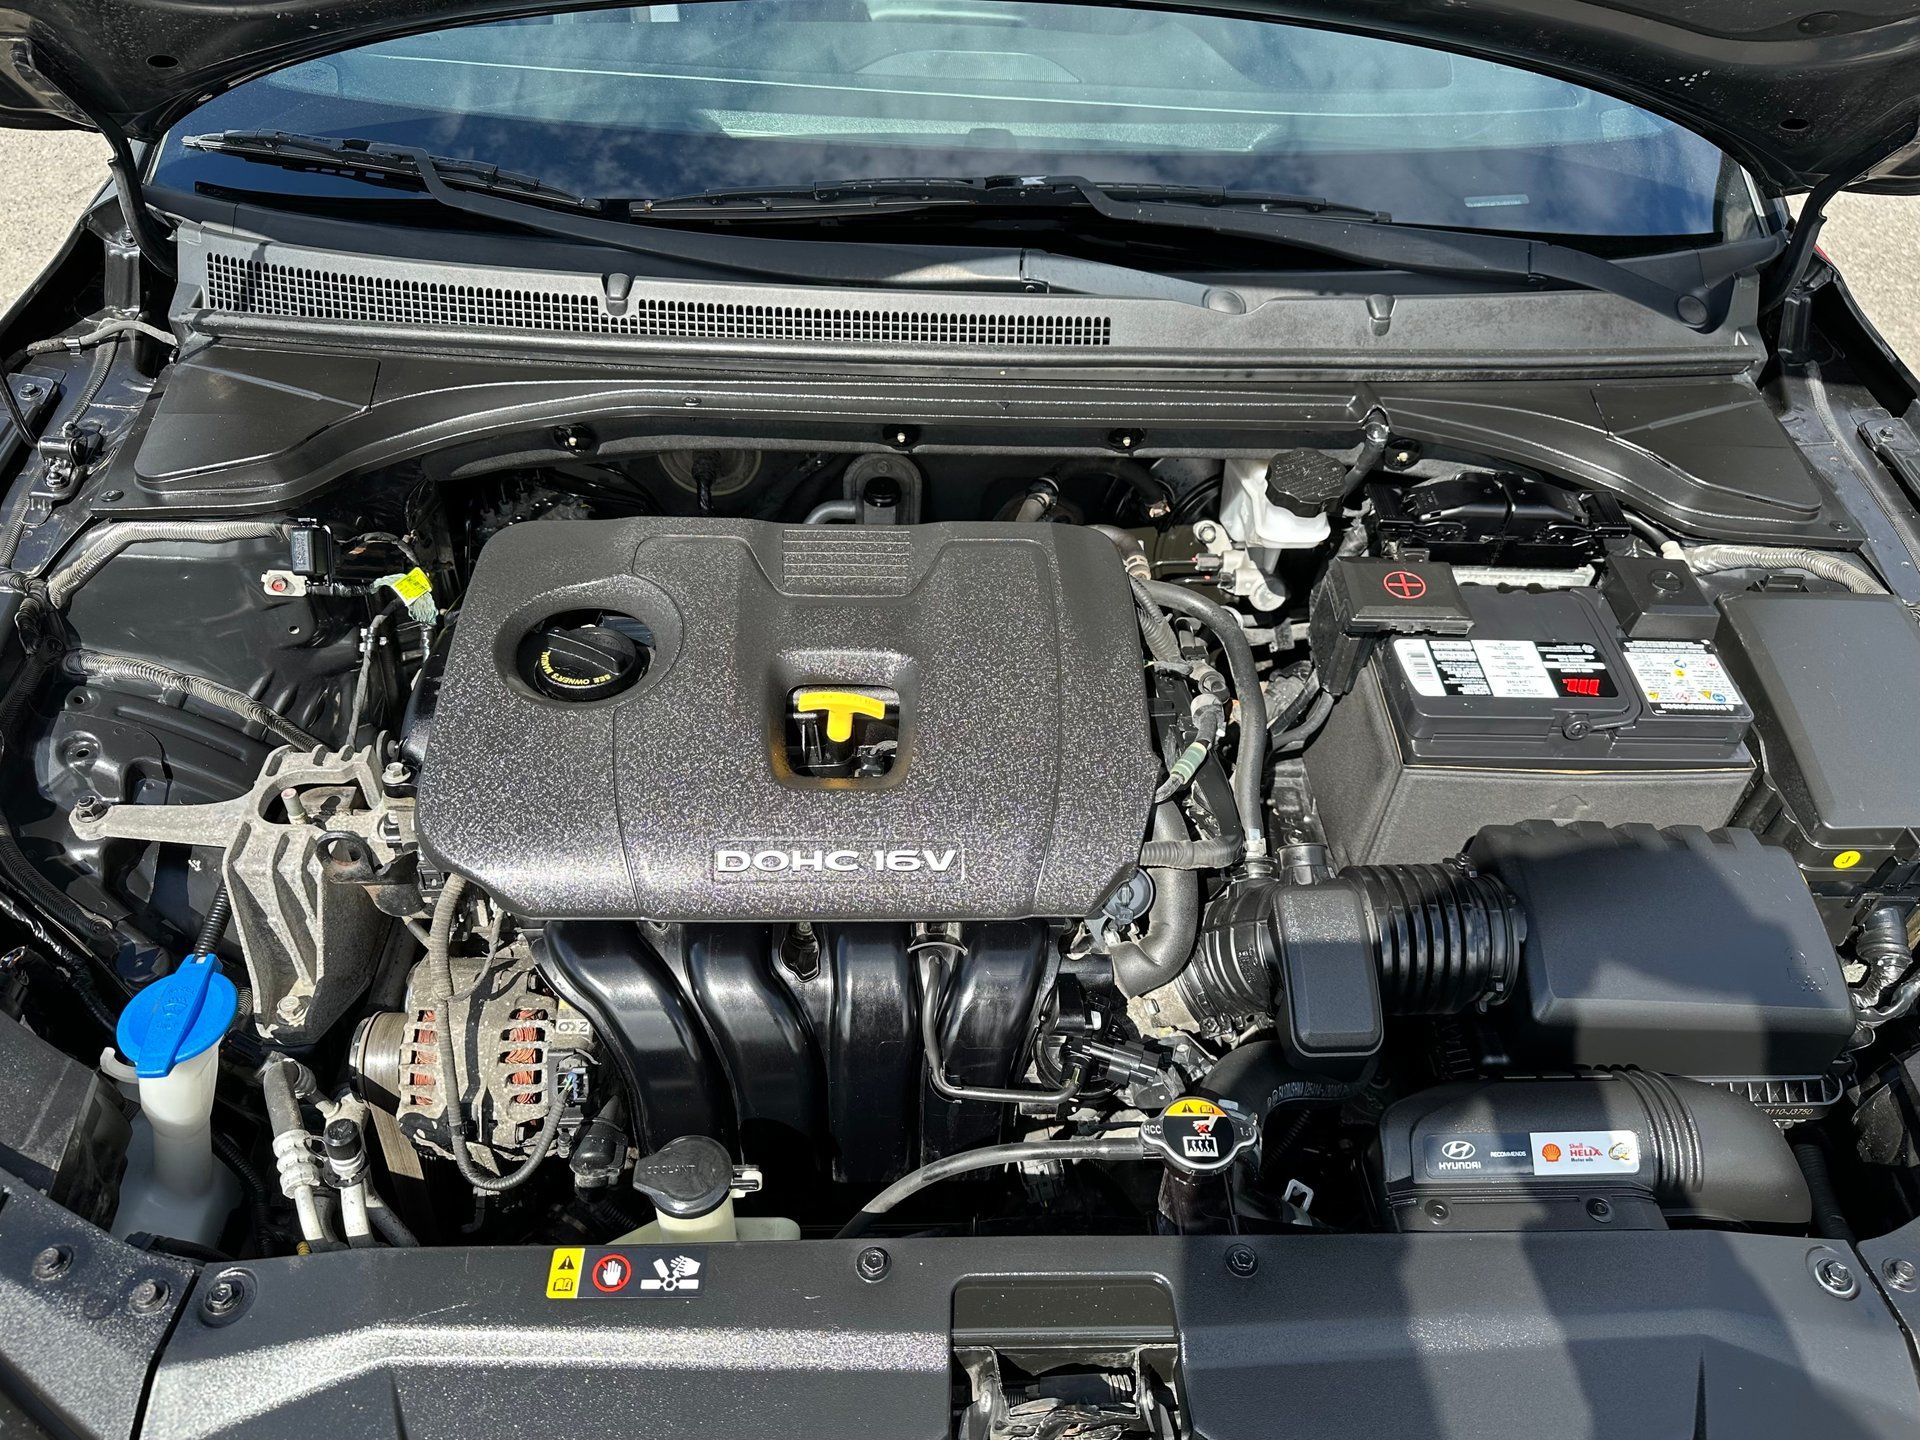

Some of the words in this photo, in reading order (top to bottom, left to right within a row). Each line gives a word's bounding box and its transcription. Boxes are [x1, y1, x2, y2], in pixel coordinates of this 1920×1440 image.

[592, 674, 611, 684] SEE
[717, 850, 860, 872] DOHC
[875, 850, 957, 872] 16V
[1143, 1125, 1162, 1135] HCC
[1570, 1148, 1603, 1157] HELIX
[647, 1164, 696, 1175] COOLANT
[1438, 1161, 1481, 1170] HYUNDAI
